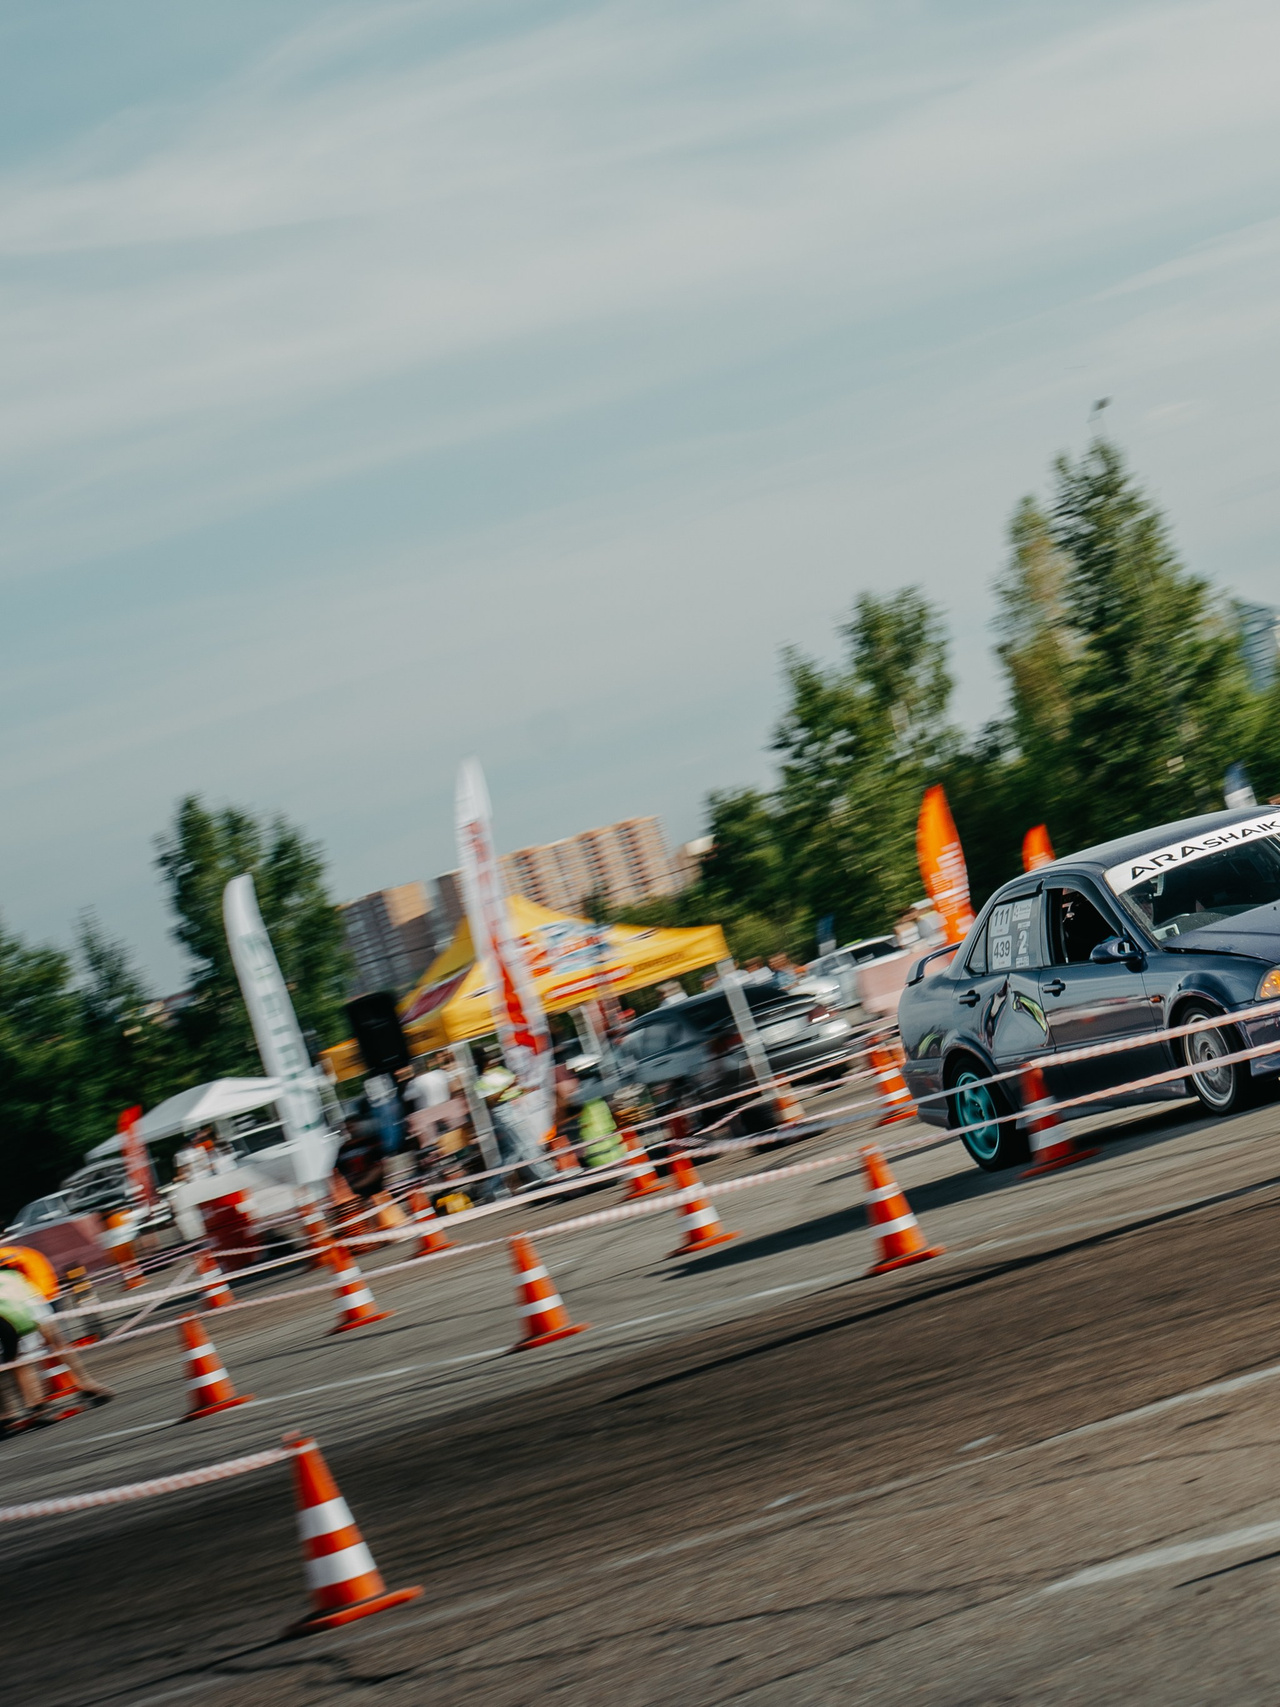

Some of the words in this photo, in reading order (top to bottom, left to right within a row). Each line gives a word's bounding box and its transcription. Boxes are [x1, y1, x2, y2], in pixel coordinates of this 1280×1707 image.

[994, 908, 1010, 927] 111
[994, 940, 1010, 959] 439
[1018, 930, 1028, 955] 2
